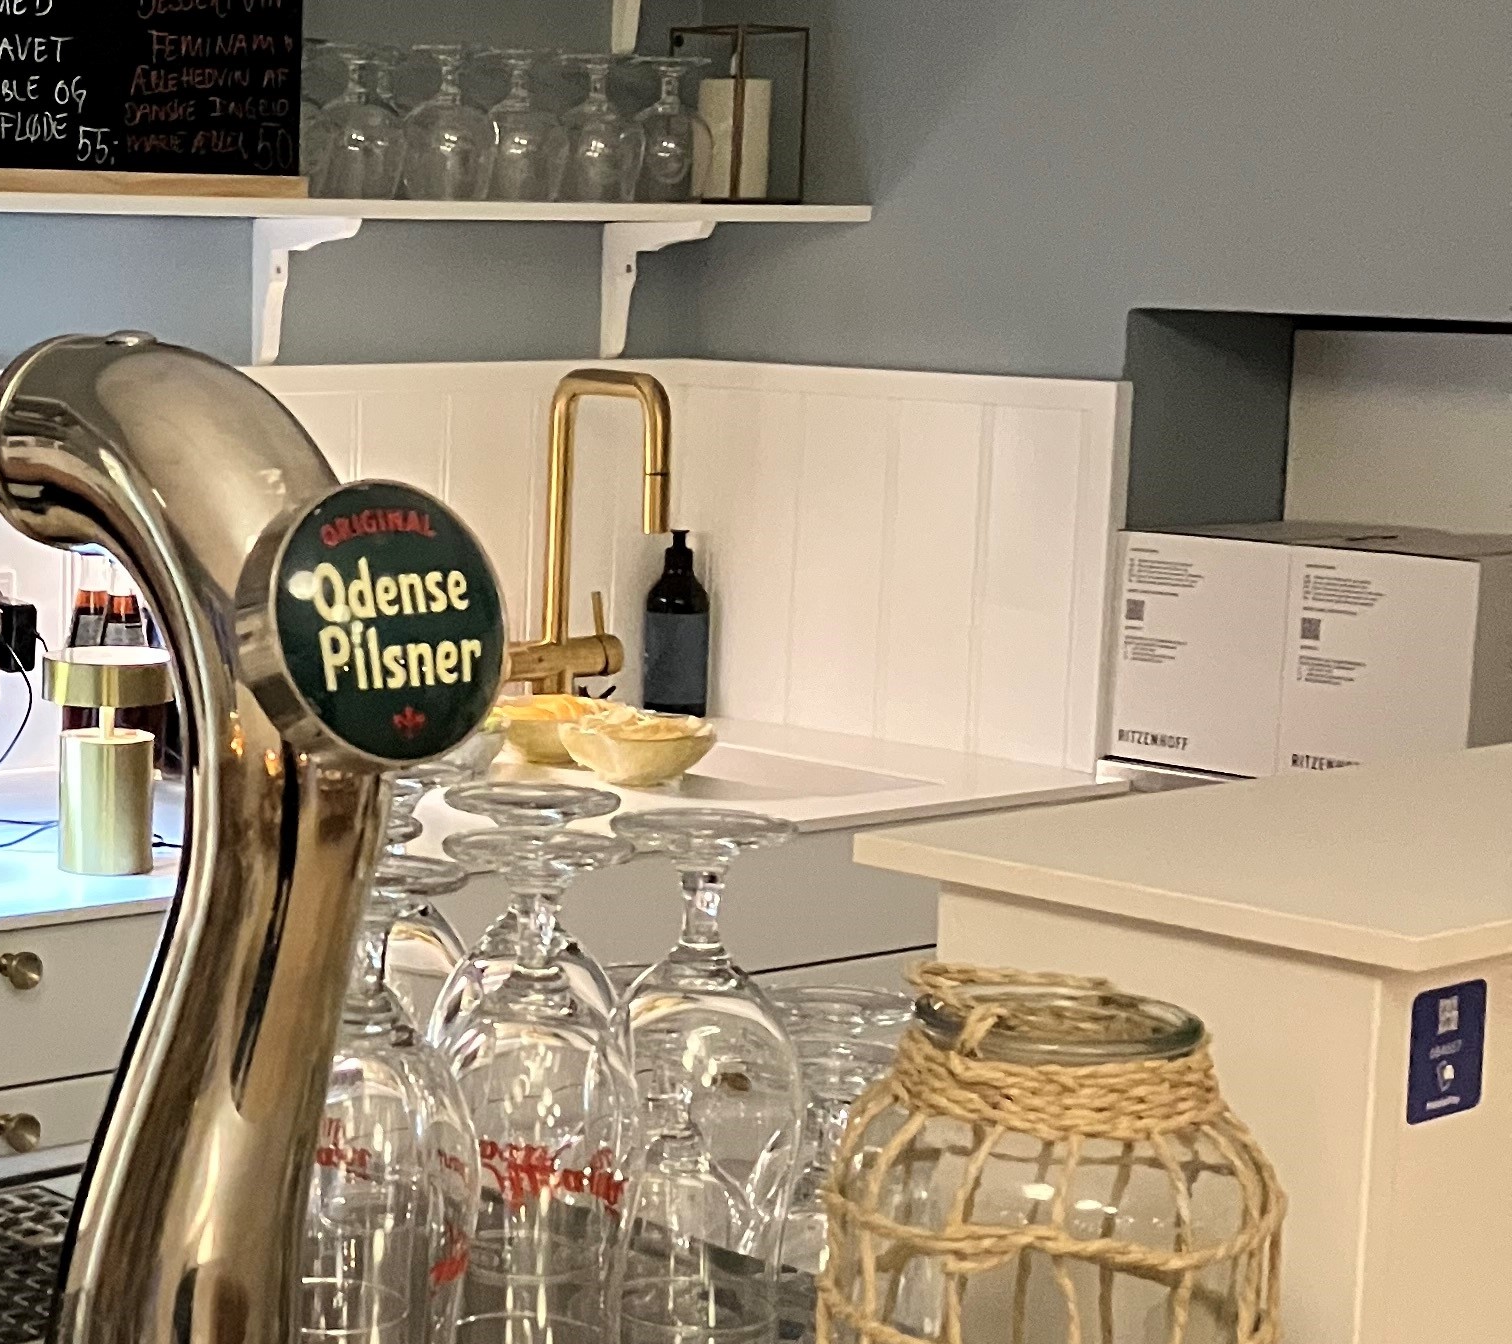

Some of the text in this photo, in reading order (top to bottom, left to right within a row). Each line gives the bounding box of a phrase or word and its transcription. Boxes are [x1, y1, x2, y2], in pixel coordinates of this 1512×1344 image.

[54, 75, 87, 114] OG
[319, 509, 438, 548] ORIGINAL
[312, 556, 471, 623] Odense
[318, 620, 483, 692] Pilsner
